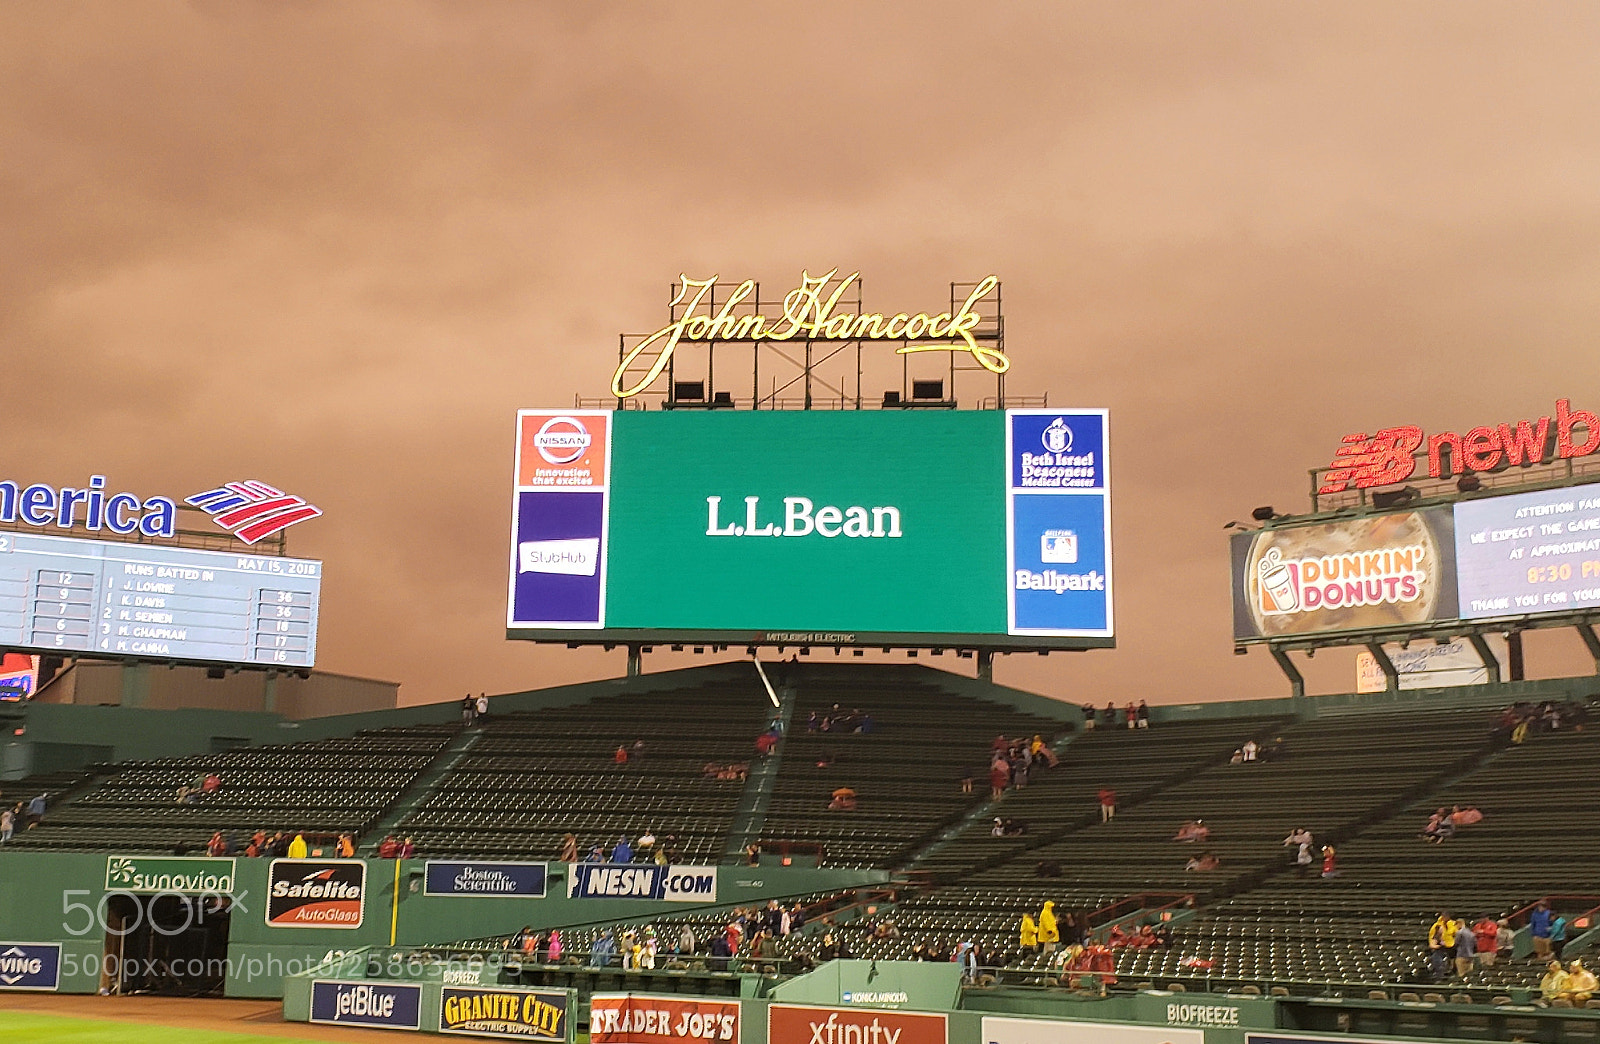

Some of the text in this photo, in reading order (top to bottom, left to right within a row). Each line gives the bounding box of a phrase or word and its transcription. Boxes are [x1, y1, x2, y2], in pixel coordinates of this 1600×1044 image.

[611, 267, 1011, 397] John Hancock
[540, 437, 585, 445] NISSAN
[1428, 416, 1551, 478] new
[1021, 452, 1094, 466] Beth Israel
[532, 477, 555, 485] that
[535, 468, 591, 478] Innovation
[1022, 466, 1095, 478] Deaconess
[1022, 477, 1060, 487] Medical
[705, 495, 903, 538] L.L.Bean
[1515, 501, 1575, 519] ATTENTION
[1471, 532, 1486, 544] WE
[1491, 525, 1535, 542] EXPECT
[1540, 522, 1564, 536] THE
[530, 551, 586, 563] StubHub
[1509, 547, 1525, 560] AT
[124, 564, 214, 581] RUNS BATTED IN
[237, 558, 264, 571] MAY
[288, 562, 316, 575] 2018
[1302, 549, 1421, 583] DUNKIN'
[1527, 563, 1572, 584] 8:30
[58, 572, 72, 585] 12
[1016, 569, 1104, 594] Ballpark
[59, 588, 69, 600] 9
[108, 577, 292, 603] 1 J. LOWRIE 36
[1304, 575, 1417, 607] DONUTS
[59, 603, 67, 615] 7
[106, 593, 291, 617] 1 K. DAVIS 36
[1471, 597, 1509, 611] THANK
[1515, 593, 1539, 607] YOU
[1543, 591, 1567, 605] FOR
[56, 619, 65, 631] 6
[103, 608, 112, 619] 2
[135, 611, 173, 624] SEMIEN
[277, 621, 288, 632] 18
[55, 634, 64, 646] 5
[102, 623, 111, 634] 3
[133, 627, 186, 640] CHAPMAN
[275, 636, 286, 647] 17
[767, 633, 856, 643] MITSUBISHI ELECTRIC
[100, 638, 109, 650] 4
[132, 641, 169, 654] CANHA
[274, 650, 286, 661] 16
[133, 869, 231, 890] sunovion
[463, 866, 503, 881] Boston
[587, 868, 655, 896] NESN
[272, 880, 361, 899] Safelite
[454, 874, 517, 892] Scientific
[295, 907, 359, 922] AutoGlass
[0, 957, 43, 975] VING
[334, 984, 395, 1020] jetBlue
[852, 992, 908, 1003] KONICA MINOLTA
[445, 993, 564, 1034] GRANITE CITY
[1167, 1004, 1239, 1024] BIOFREEZE
[465, 1020, 540, 1035] ELECTRIC SUPPLY
[590, 1009, 736, 1040] TRADER JOE'S
[809, 1013, 902, 1044] xfinity
